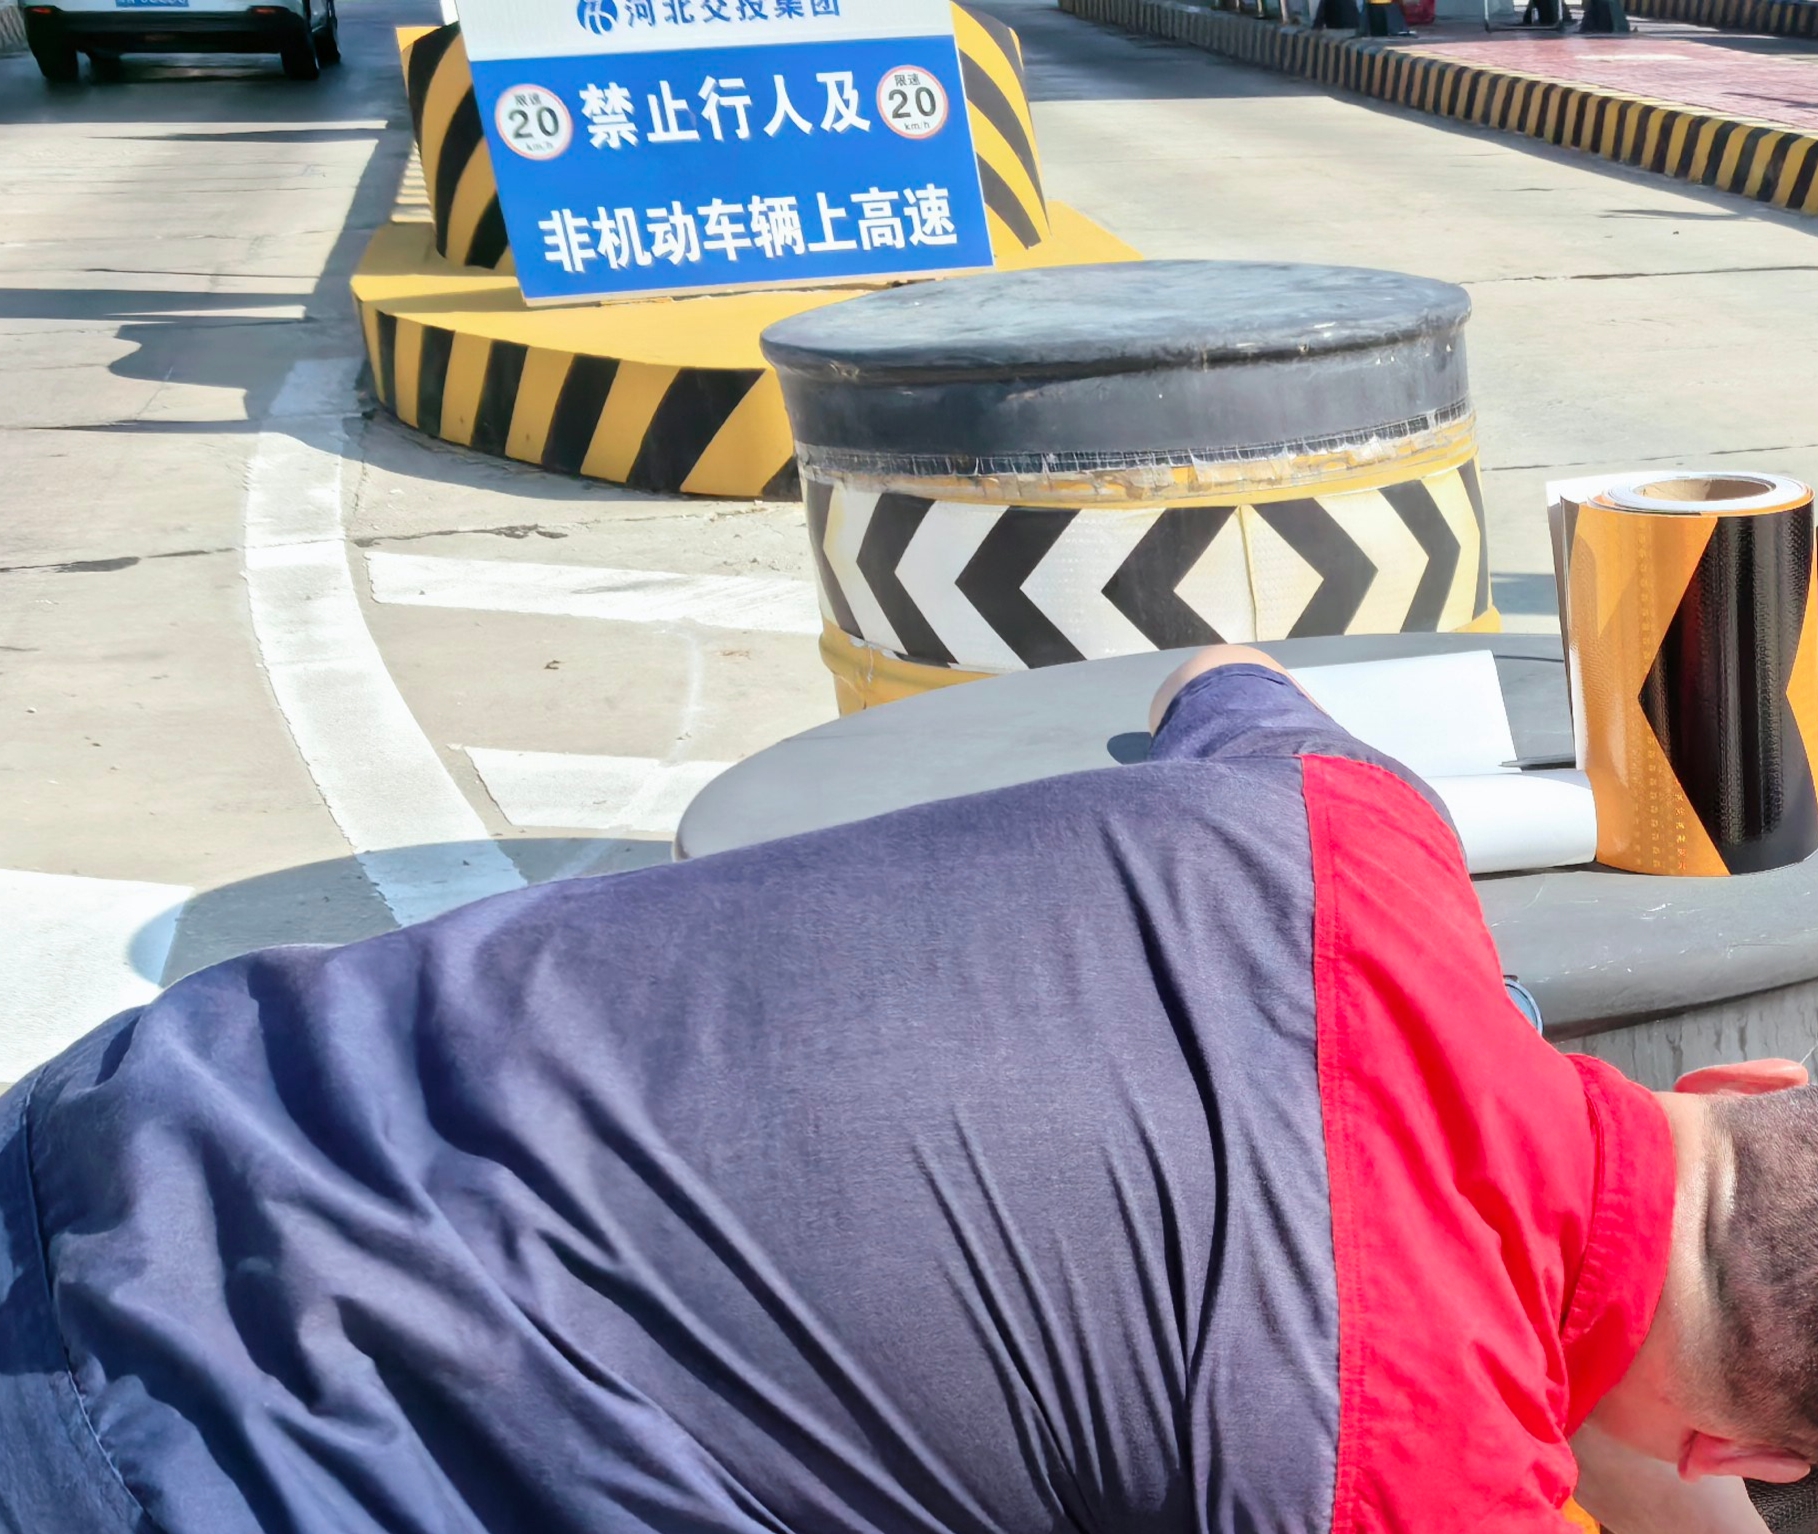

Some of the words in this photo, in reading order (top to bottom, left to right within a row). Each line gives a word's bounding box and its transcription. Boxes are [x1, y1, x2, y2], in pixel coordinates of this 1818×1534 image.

[508, 106, 559, 139] 20
[578, 70, 871, 150] 禁止行人及
[888, 86, 936, 119] 20
[538, 183, 958, 273] 非机动车辆上高速
